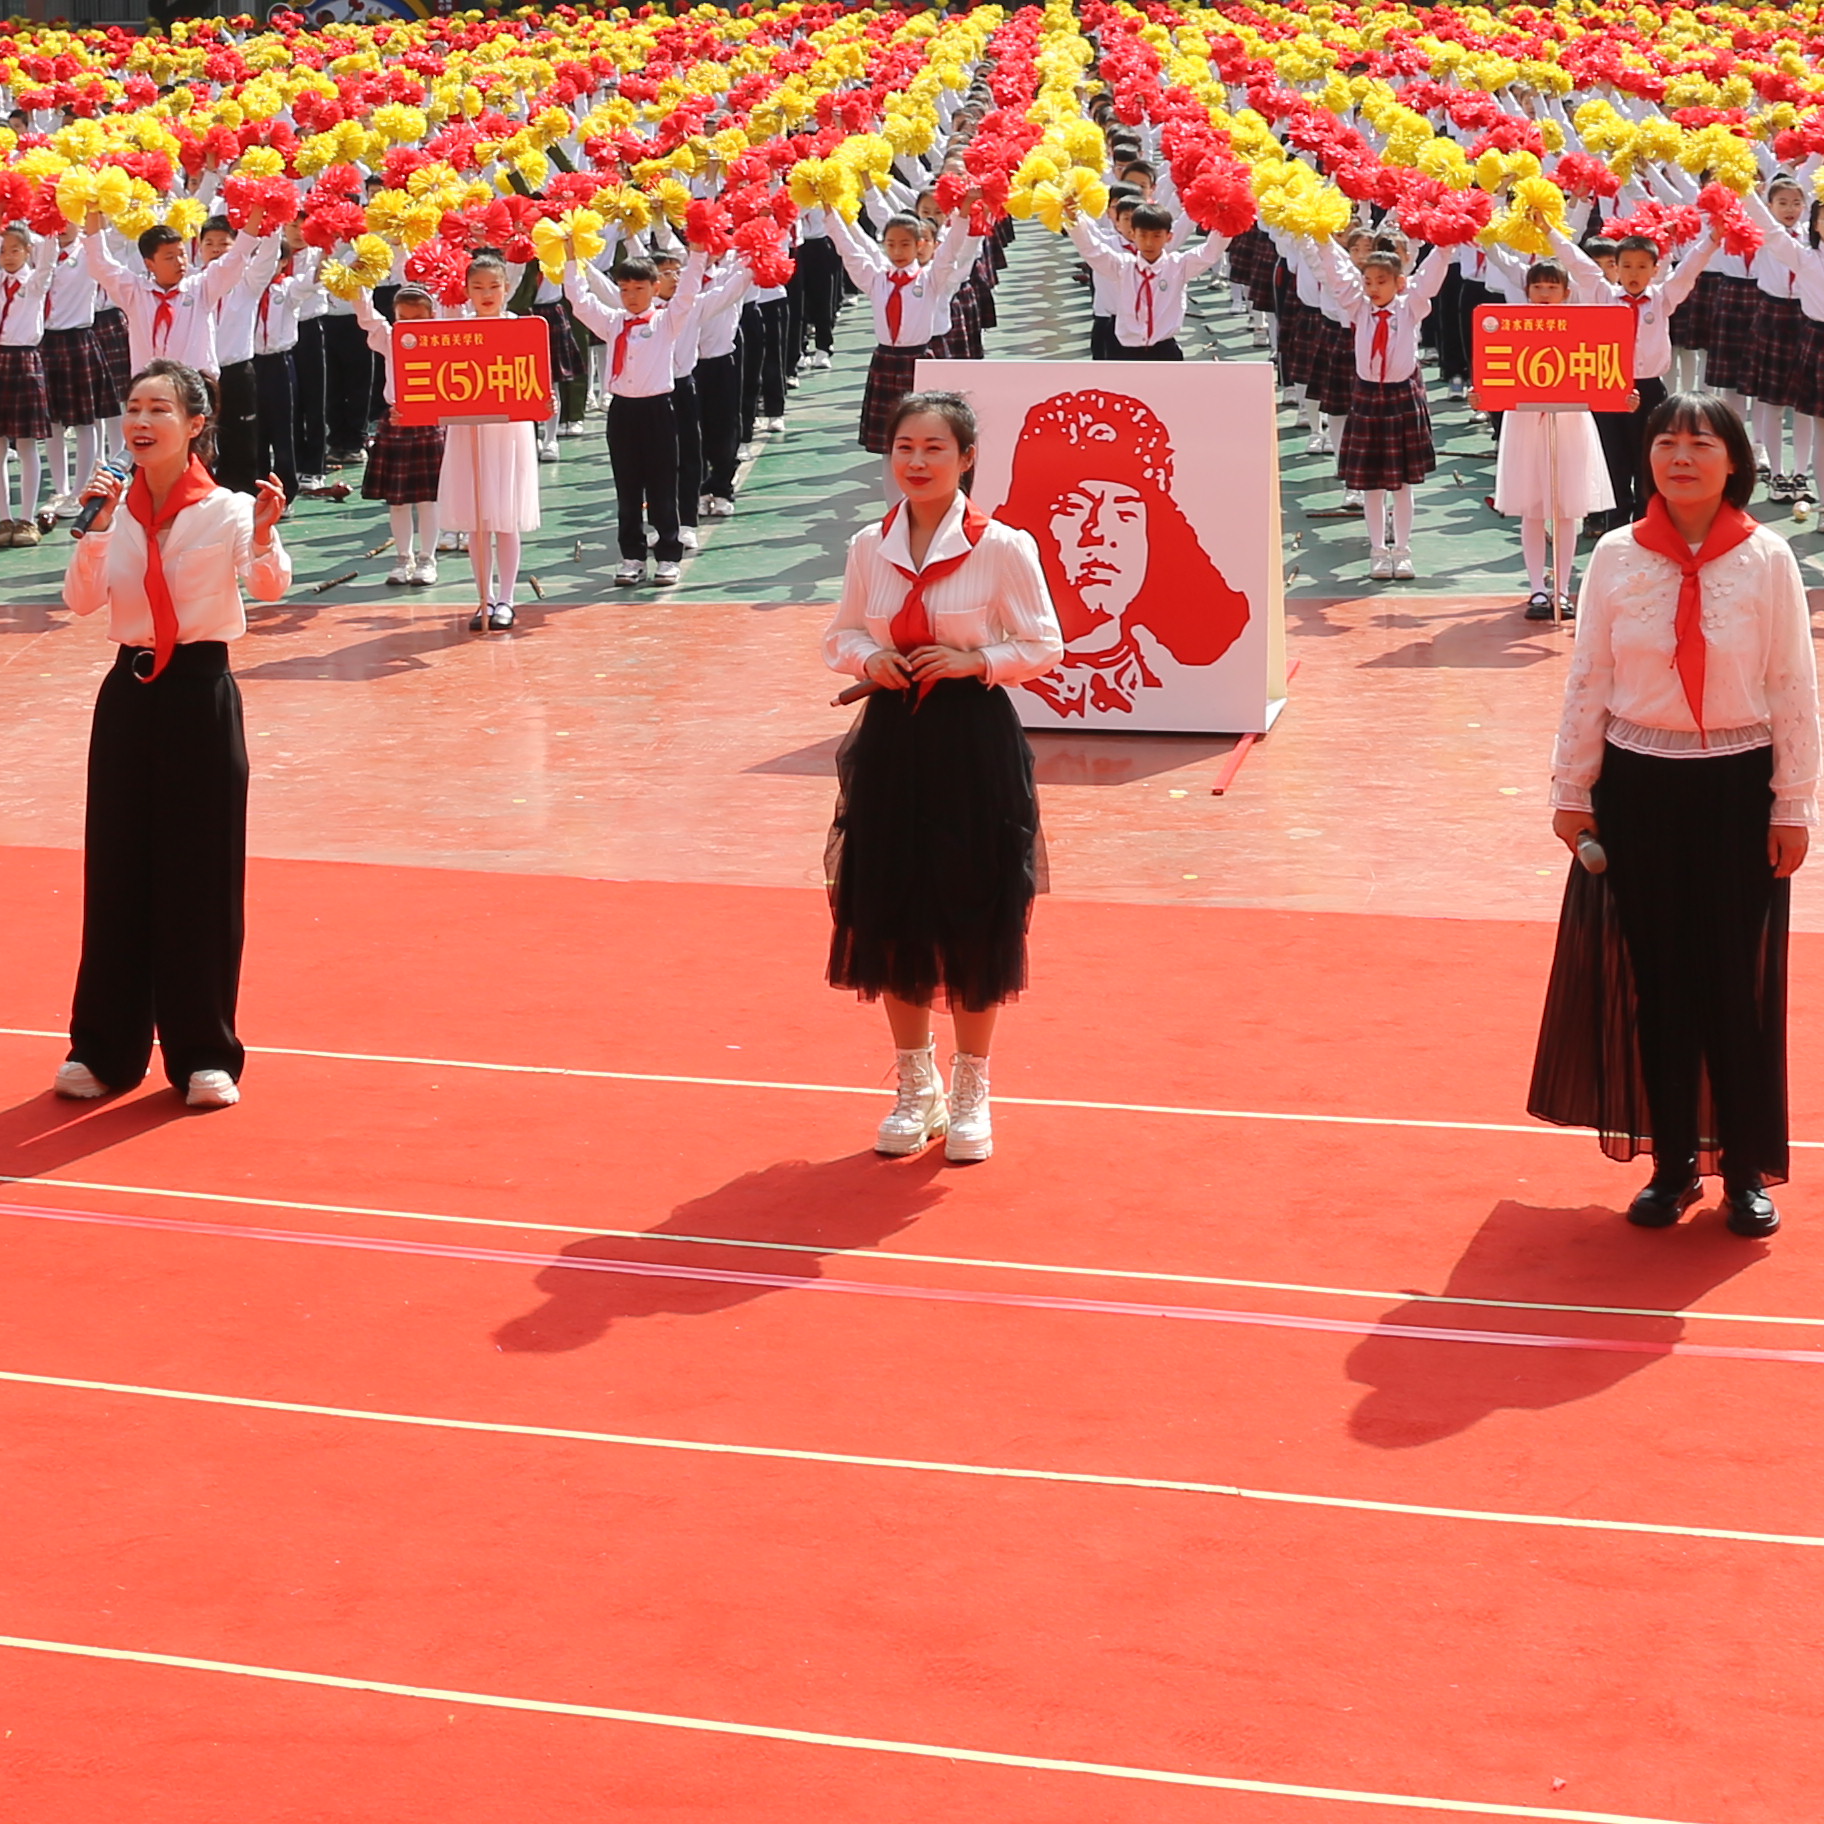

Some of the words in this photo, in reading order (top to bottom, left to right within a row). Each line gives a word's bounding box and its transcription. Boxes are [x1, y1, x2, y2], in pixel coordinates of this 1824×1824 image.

[403, 354, 545, 403] 三(5)中队
[1482, 342, 1627, 391] 三(6)中队
